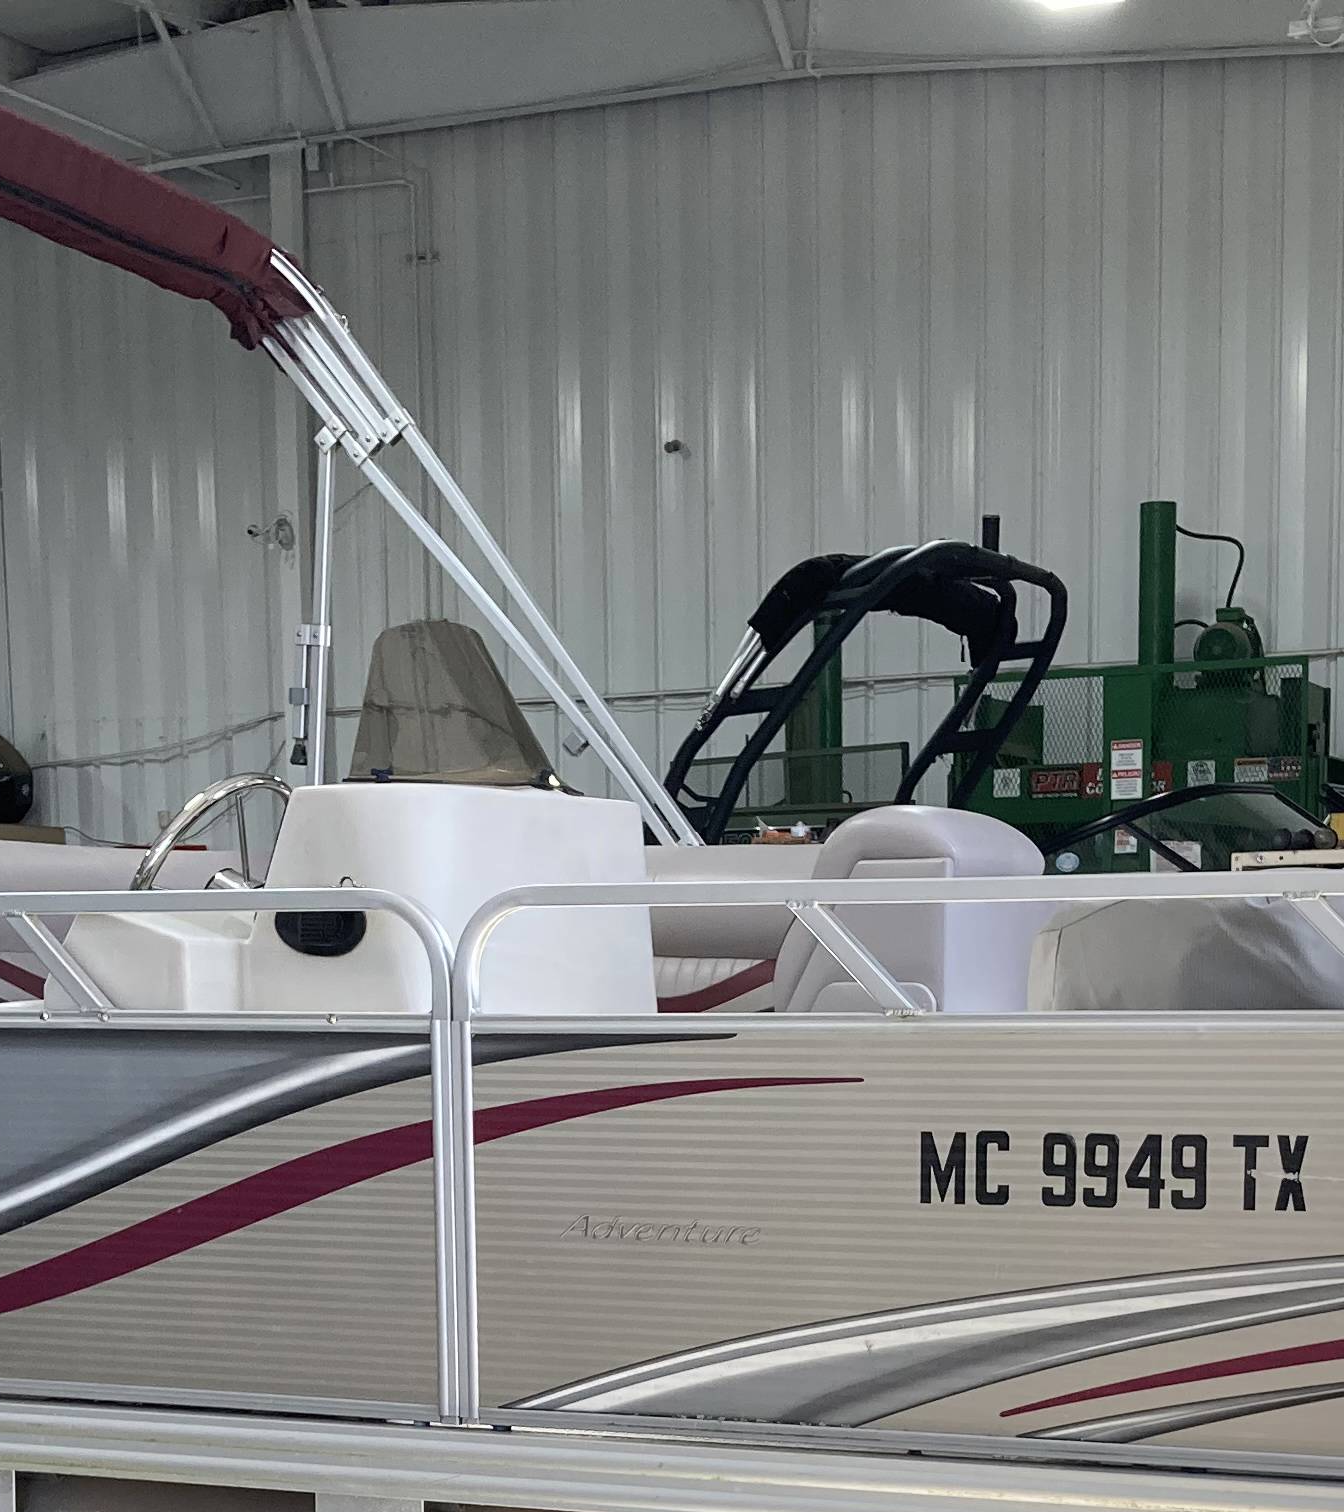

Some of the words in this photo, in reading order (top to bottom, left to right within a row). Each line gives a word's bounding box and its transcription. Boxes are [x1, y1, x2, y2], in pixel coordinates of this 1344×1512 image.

[919, 1130, 1010, 1206] MC
[1041, 1132, 1209, 1211] 9949
[1232, 1134, 1310, 1212] TX
[559, 1213, 762, 1245] Adventure
